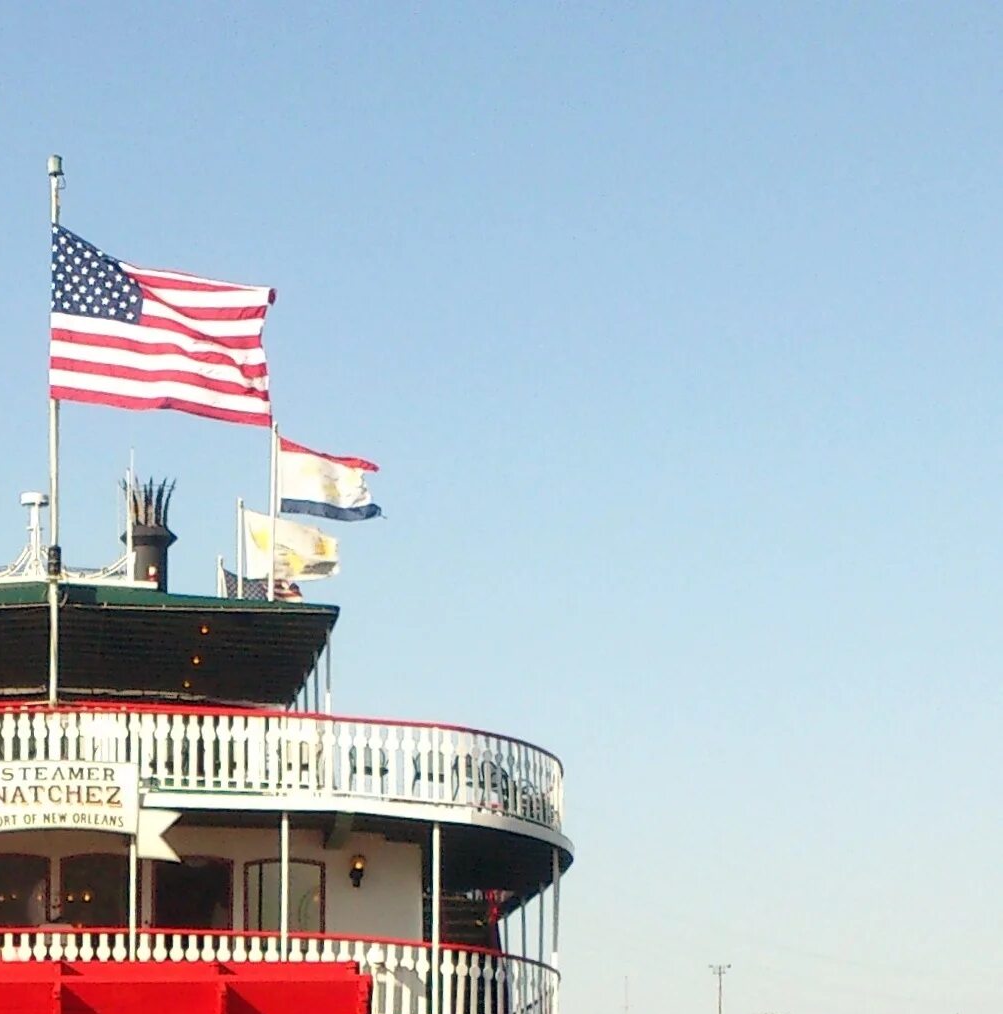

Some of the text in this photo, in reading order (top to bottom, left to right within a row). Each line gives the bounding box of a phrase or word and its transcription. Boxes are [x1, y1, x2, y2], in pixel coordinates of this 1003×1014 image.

[1, 767, 115, 781] STEAMER
[23, 814, 38, 825] OF
[43, 812, 68, 824] NEW
[72, 812, 124, 828] ORLEANS
